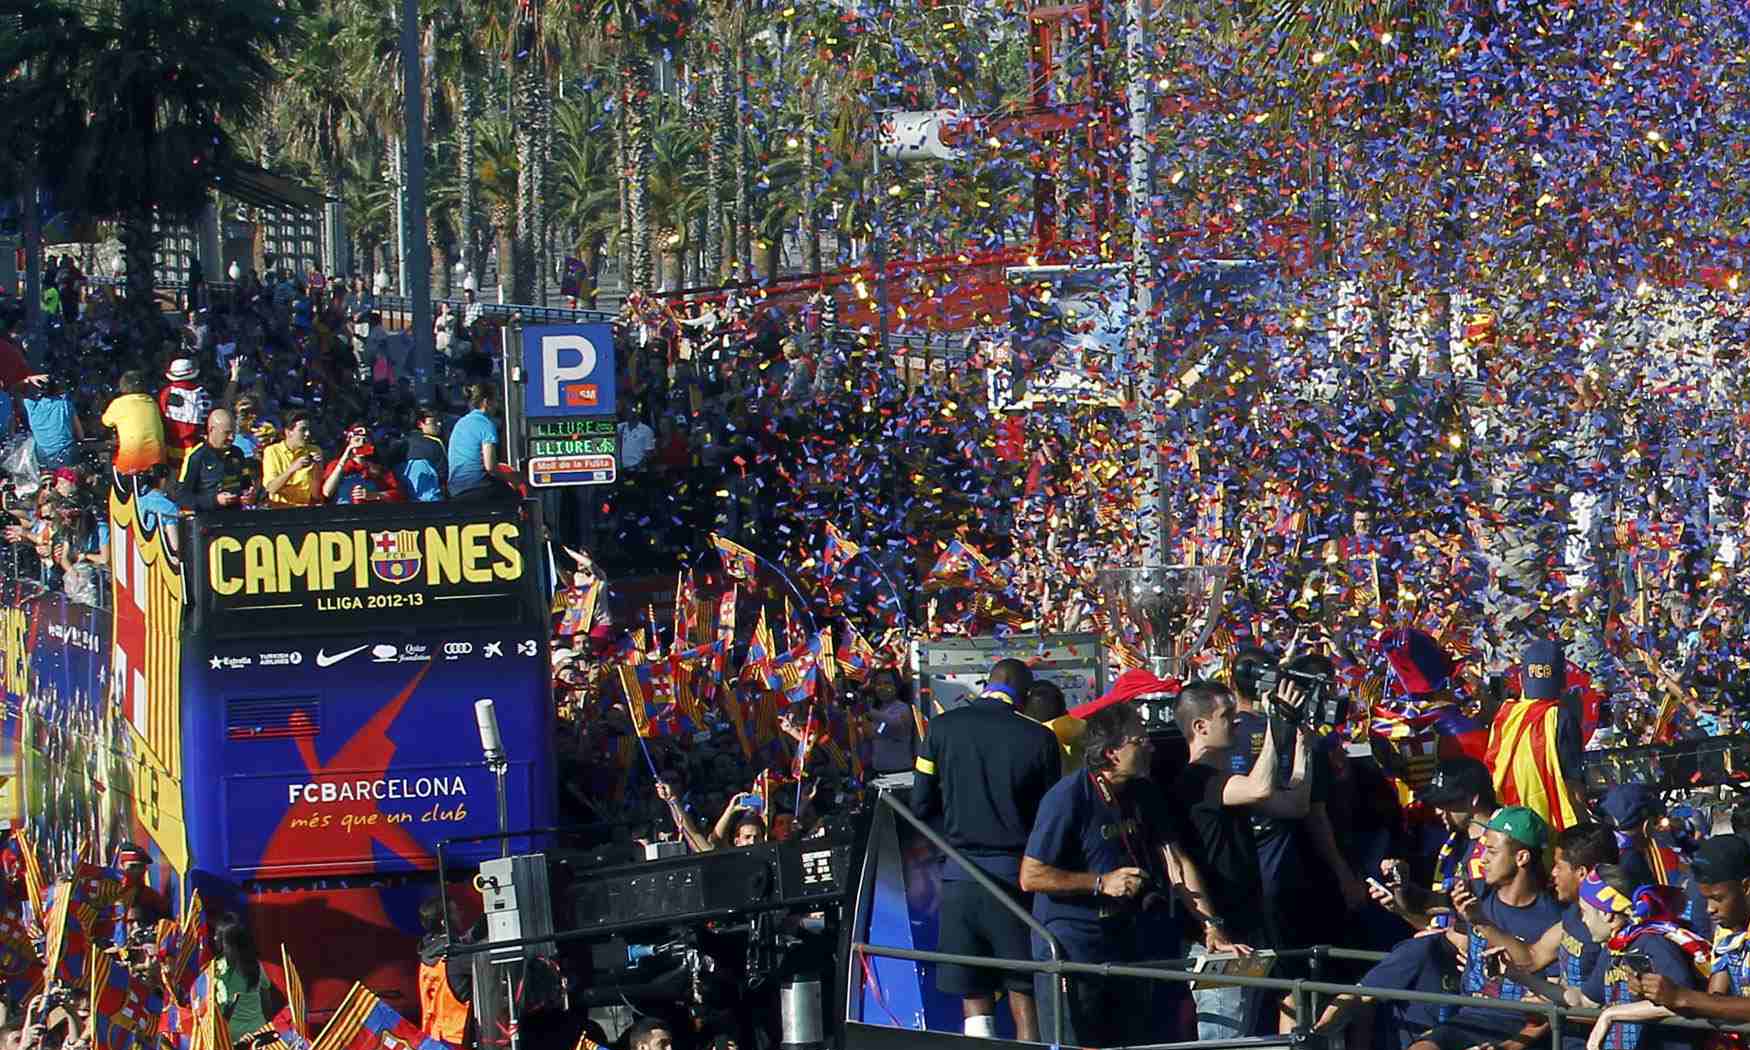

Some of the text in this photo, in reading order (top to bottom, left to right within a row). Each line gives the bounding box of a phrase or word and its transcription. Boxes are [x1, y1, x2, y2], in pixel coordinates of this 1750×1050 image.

[542, 335, 596, 406] P
[538, 421, 594, 435] LLIURE
[536, 440, 593, 455] LLIURE
[317, 593, 424, 611] LLIGA 2012-13
[288, 776, 467, 803] FCBARCELONA
[290, 803, 468, 833] més que un club
